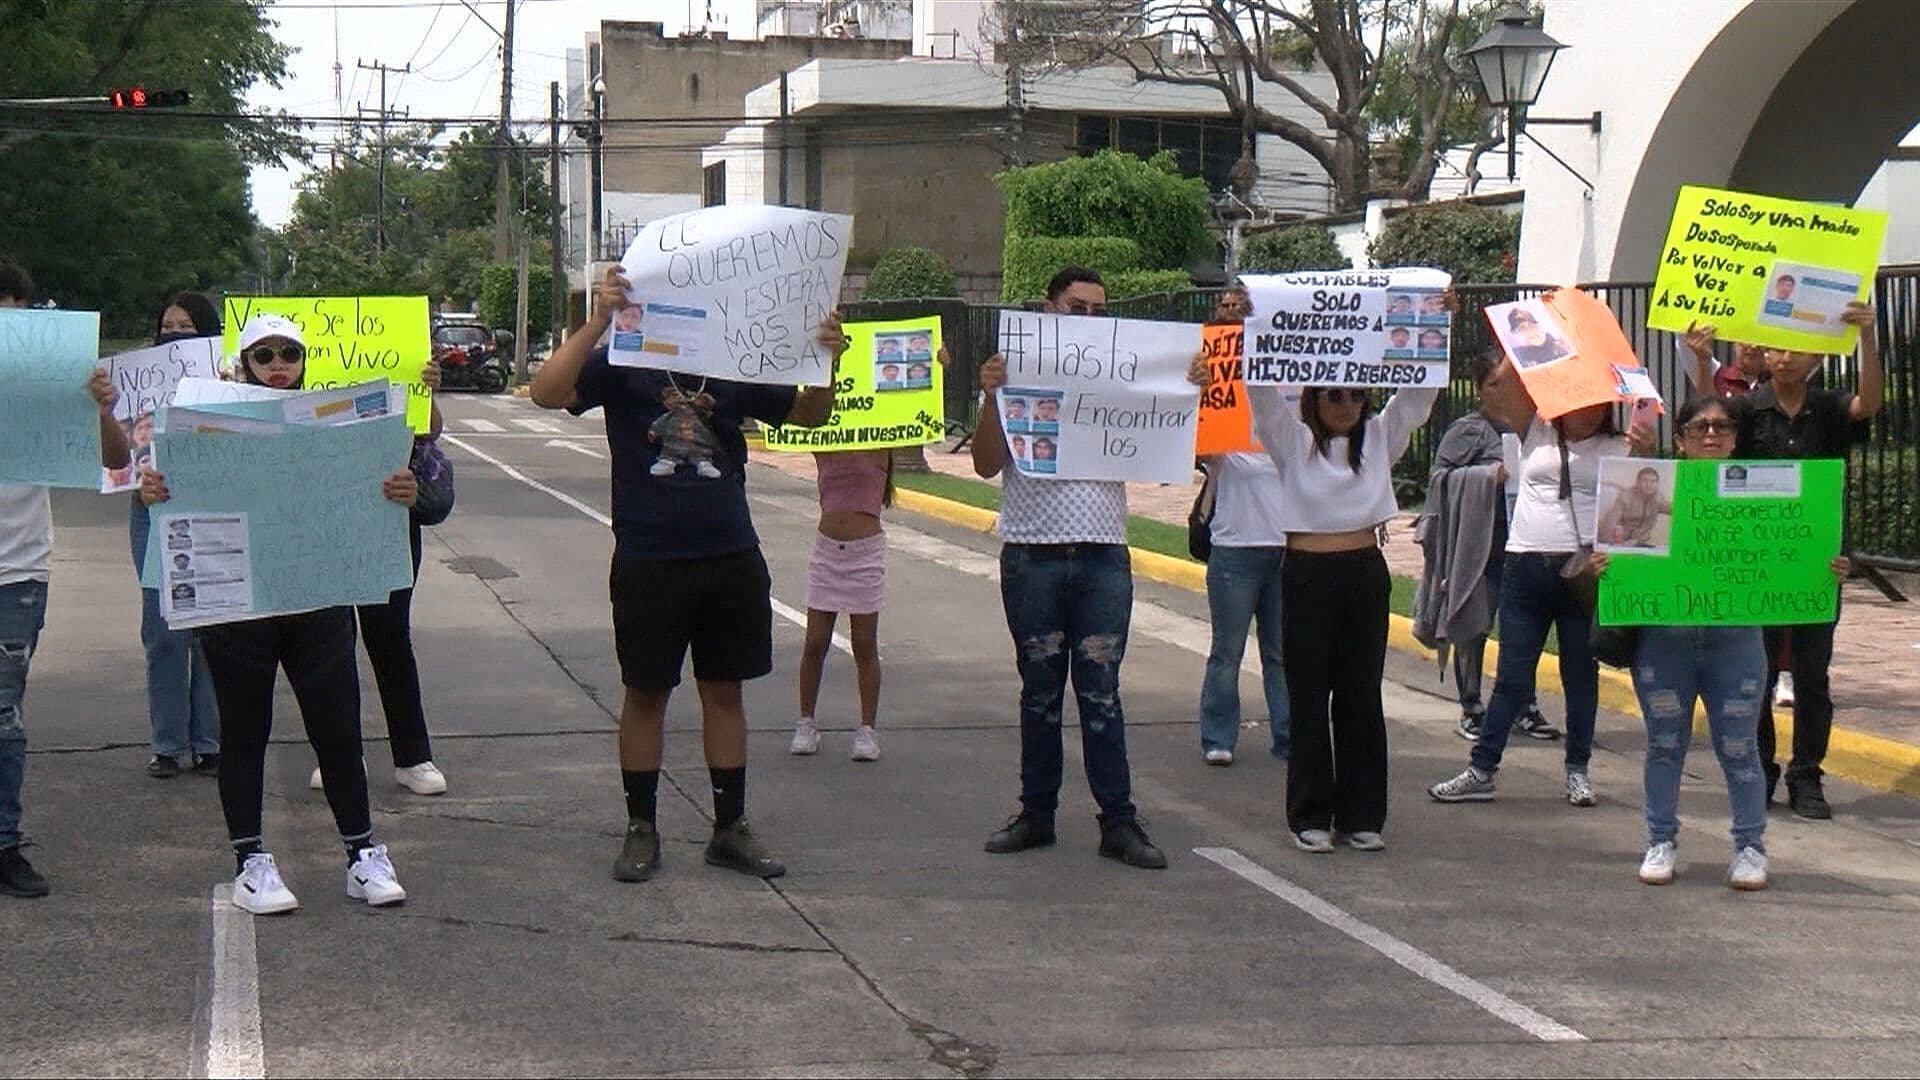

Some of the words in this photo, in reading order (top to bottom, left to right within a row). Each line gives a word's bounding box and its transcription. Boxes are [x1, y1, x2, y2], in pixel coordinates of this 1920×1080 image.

[1700, 199, 1737, 217] Solo
[668, 218, 839, 289] QUEREMOS
[715, 296, 729, 332] Y
[744, 265, 832, 318] ESPERA
[1657, 290, 1669, 308] A
[1699, 295, 1736, 317] hijo
[314, 299, 345, 337] Se
[356, 297, 385, 336] los
[1272, 310, 1369, 331] QUEREMOS
[1372, 315, 1384, 332] A
[724, 315, 789, 360] MOS
[1000, 317, 1138, 382] #Hasta
[1256, 334, 1354, 355] NUESTROS
[338, 341, 400, 370] Vivo
[738, 340, 821, 377] CASA
[1247, 357, 1313, 382] HIJOS
[1314, 361, 1339, 381] DE
[1344, 362, 1426, 384] REGRESO
[1073, 393, 1193, 430] Encontrar
[767, 427, 855, 446] ENTIENDAN
[858, 424, 923, 443] NUESTRO
[1103, 430, 1137, 458] los
